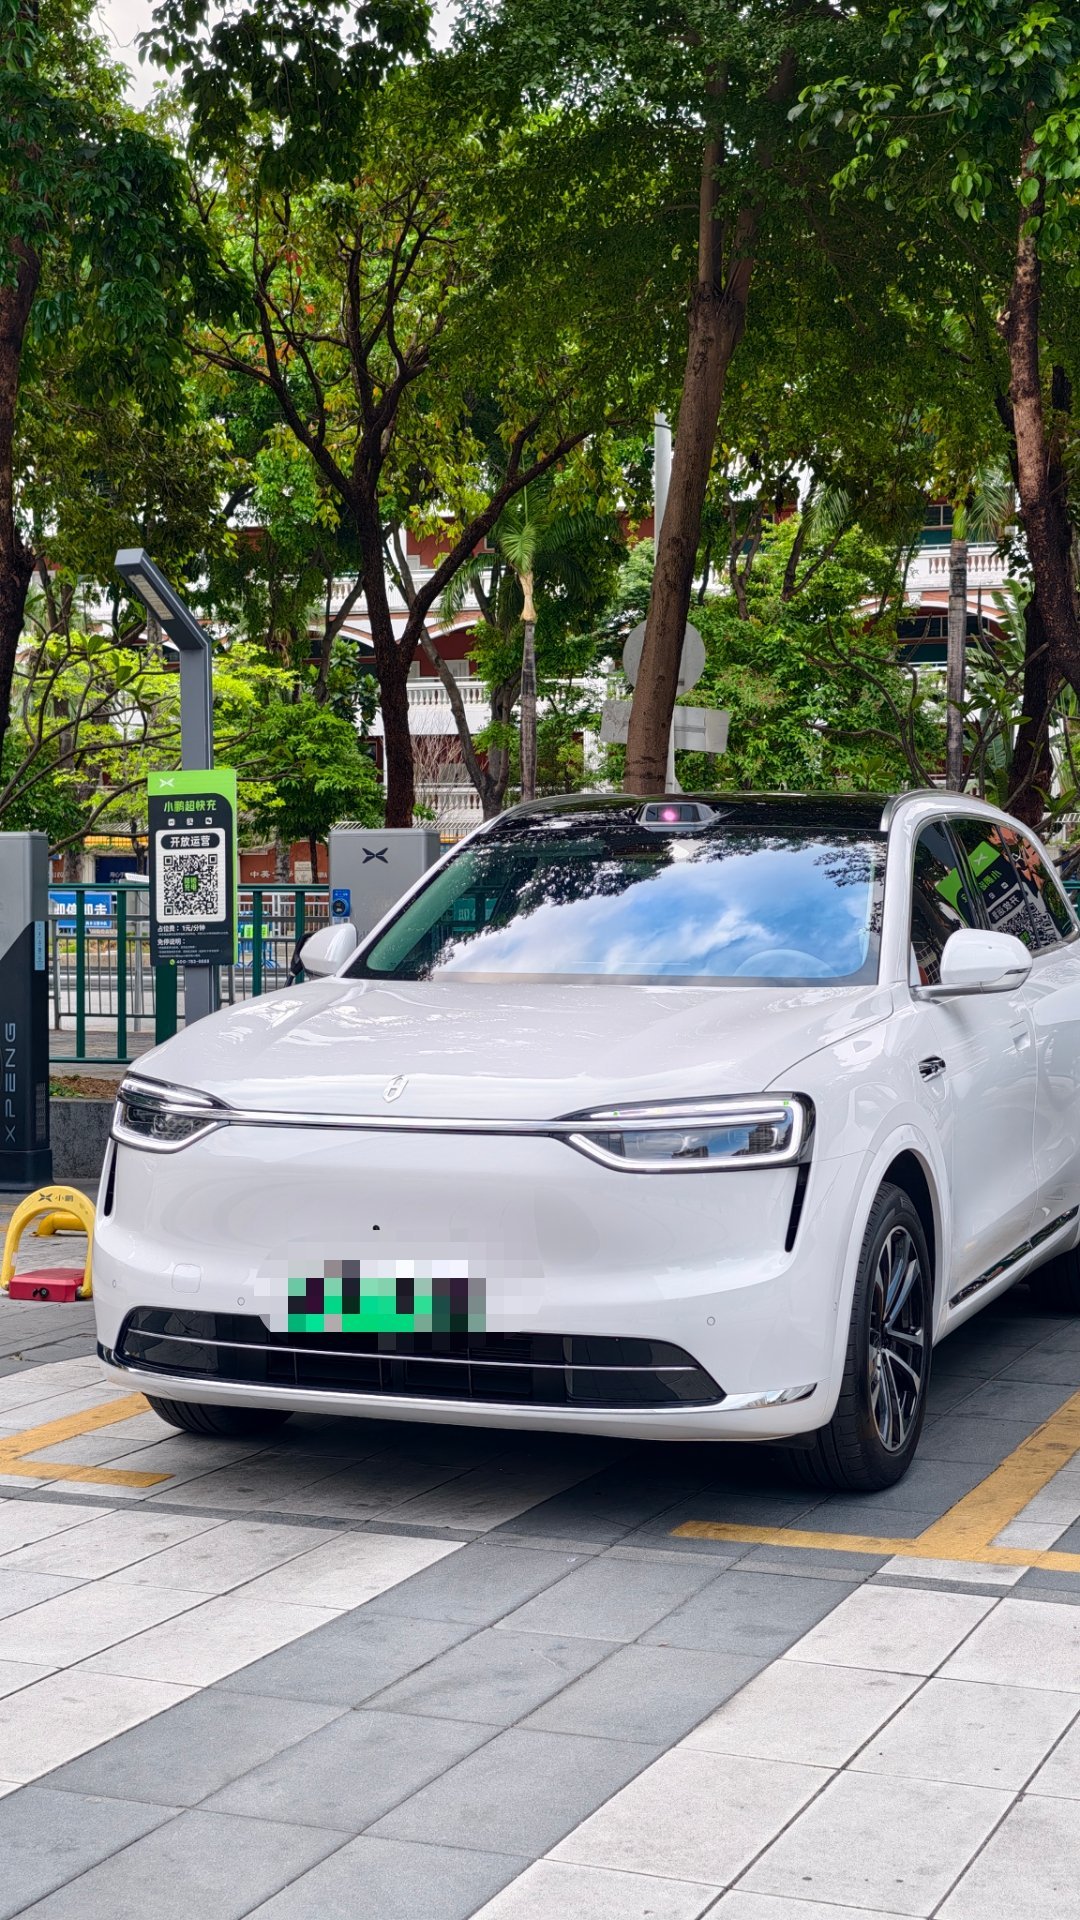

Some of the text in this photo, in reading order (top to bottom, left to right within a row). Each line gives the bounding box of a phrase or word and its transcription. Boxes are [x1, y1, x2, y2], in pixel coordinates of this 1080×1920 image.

[164, 800, 216, 812] 小鹏超快充
[170, 836, 210, 848] 开放运营
[5, 1022, 16, 1143] XPENG
